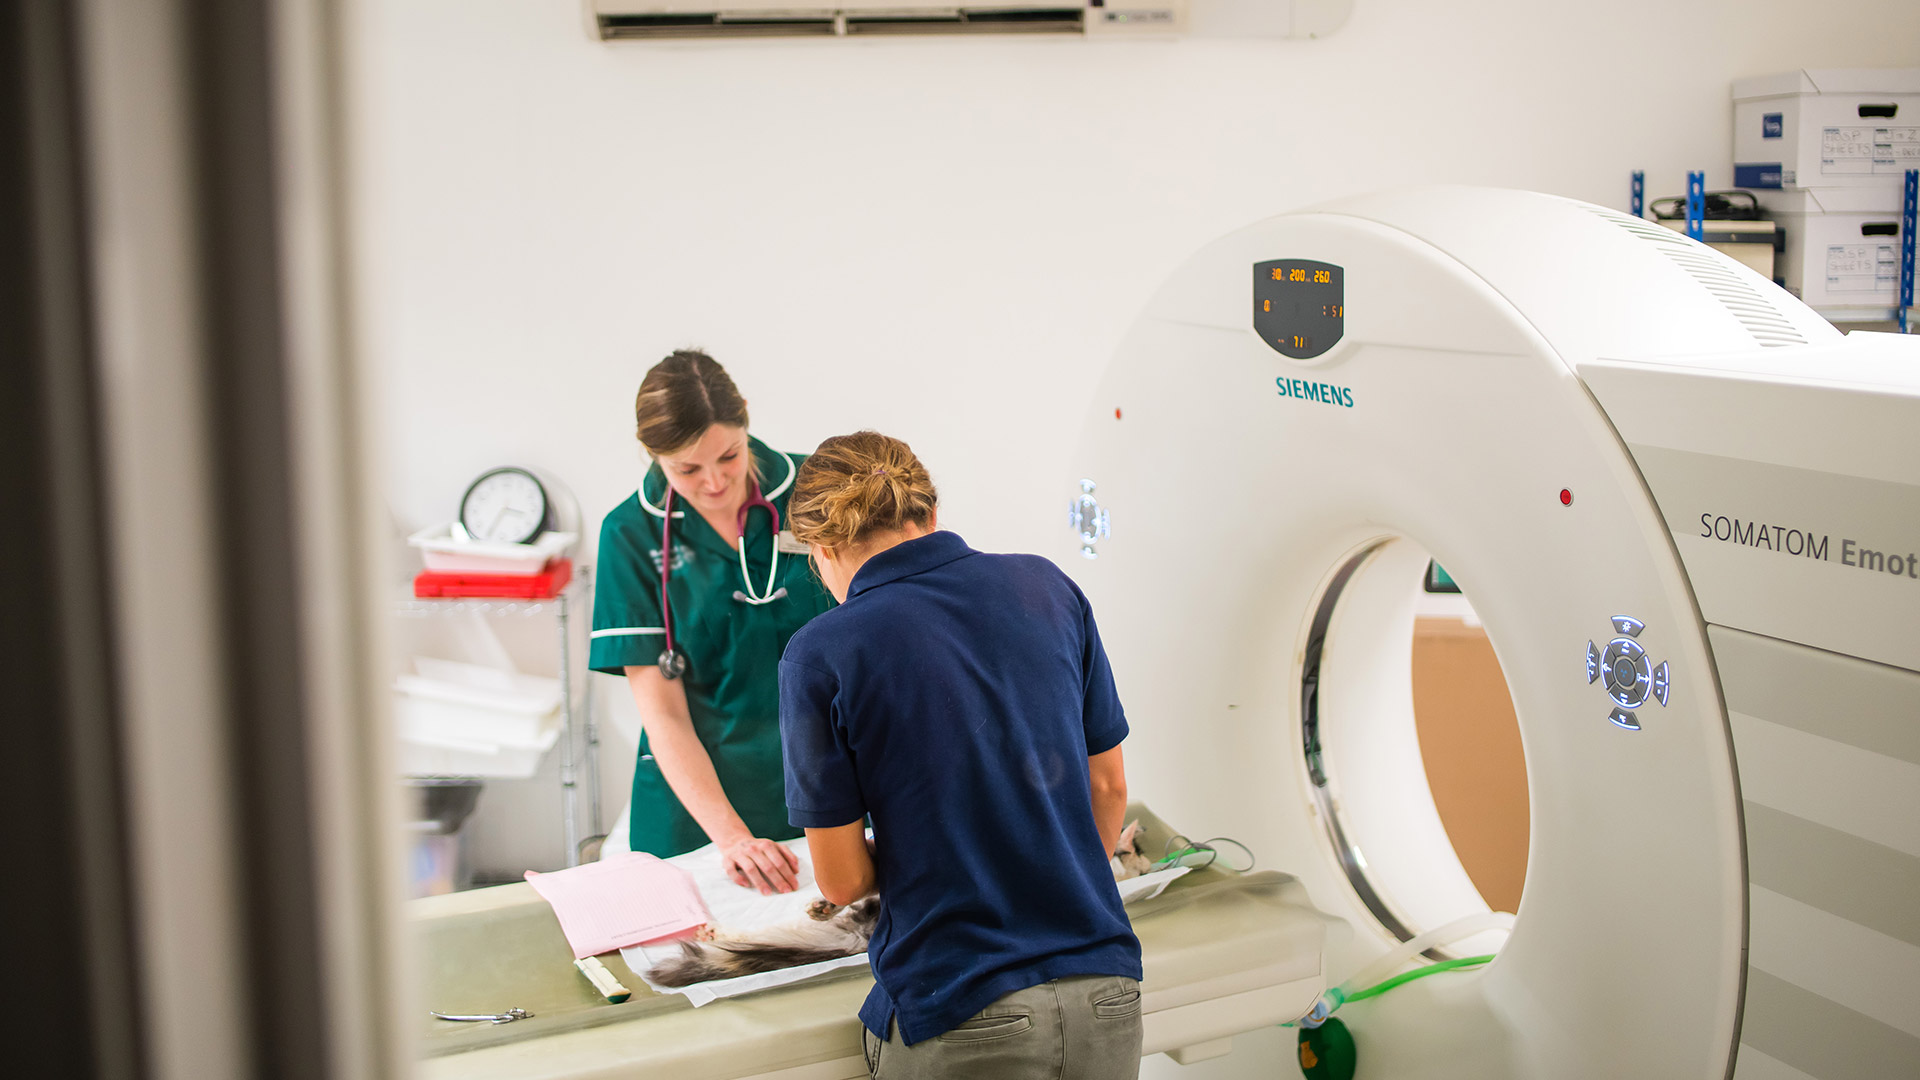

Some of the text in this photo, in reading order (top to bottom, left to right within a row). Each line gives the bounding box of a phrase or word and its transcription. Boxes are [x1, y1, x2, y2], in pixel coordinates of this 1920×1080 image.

[1823, 143, 1871, 154] SHEETS
[1289, 268, 1306, 282] 200
[1313, 270, 1330, 284] 260
[1276, 377, 1354, 408] SIEMENS
[1701, 513, 1919, 579] SOMATOM Emot
